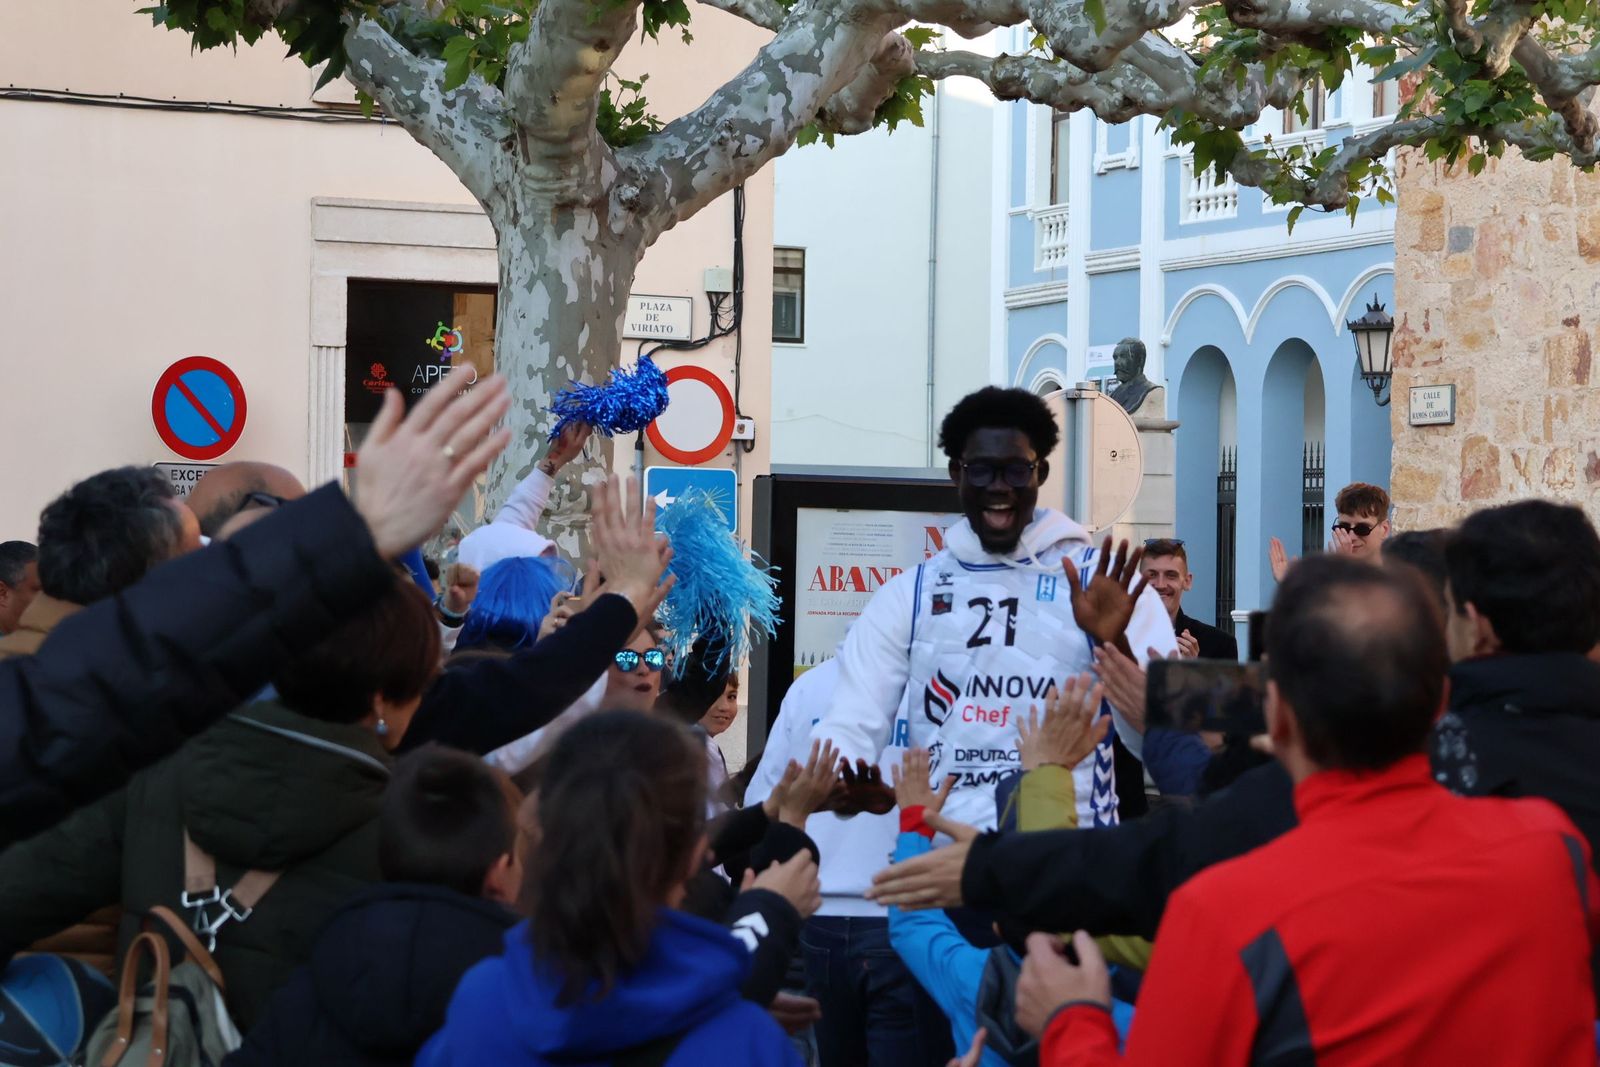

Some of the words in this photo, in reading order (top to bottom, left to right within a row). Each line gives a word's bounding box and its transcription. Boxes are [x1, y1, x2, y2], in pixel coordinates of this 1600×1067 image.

[640, 302, 672, 311] PLAZA
[645, 313, 659, 321] DE
[631, 323, 673, 333] VIRIATO
[966, 596, 1019, 649] 21
[966, 674, 1058, 700] INNOVA
[962, 705, 1011, 727] Chef
